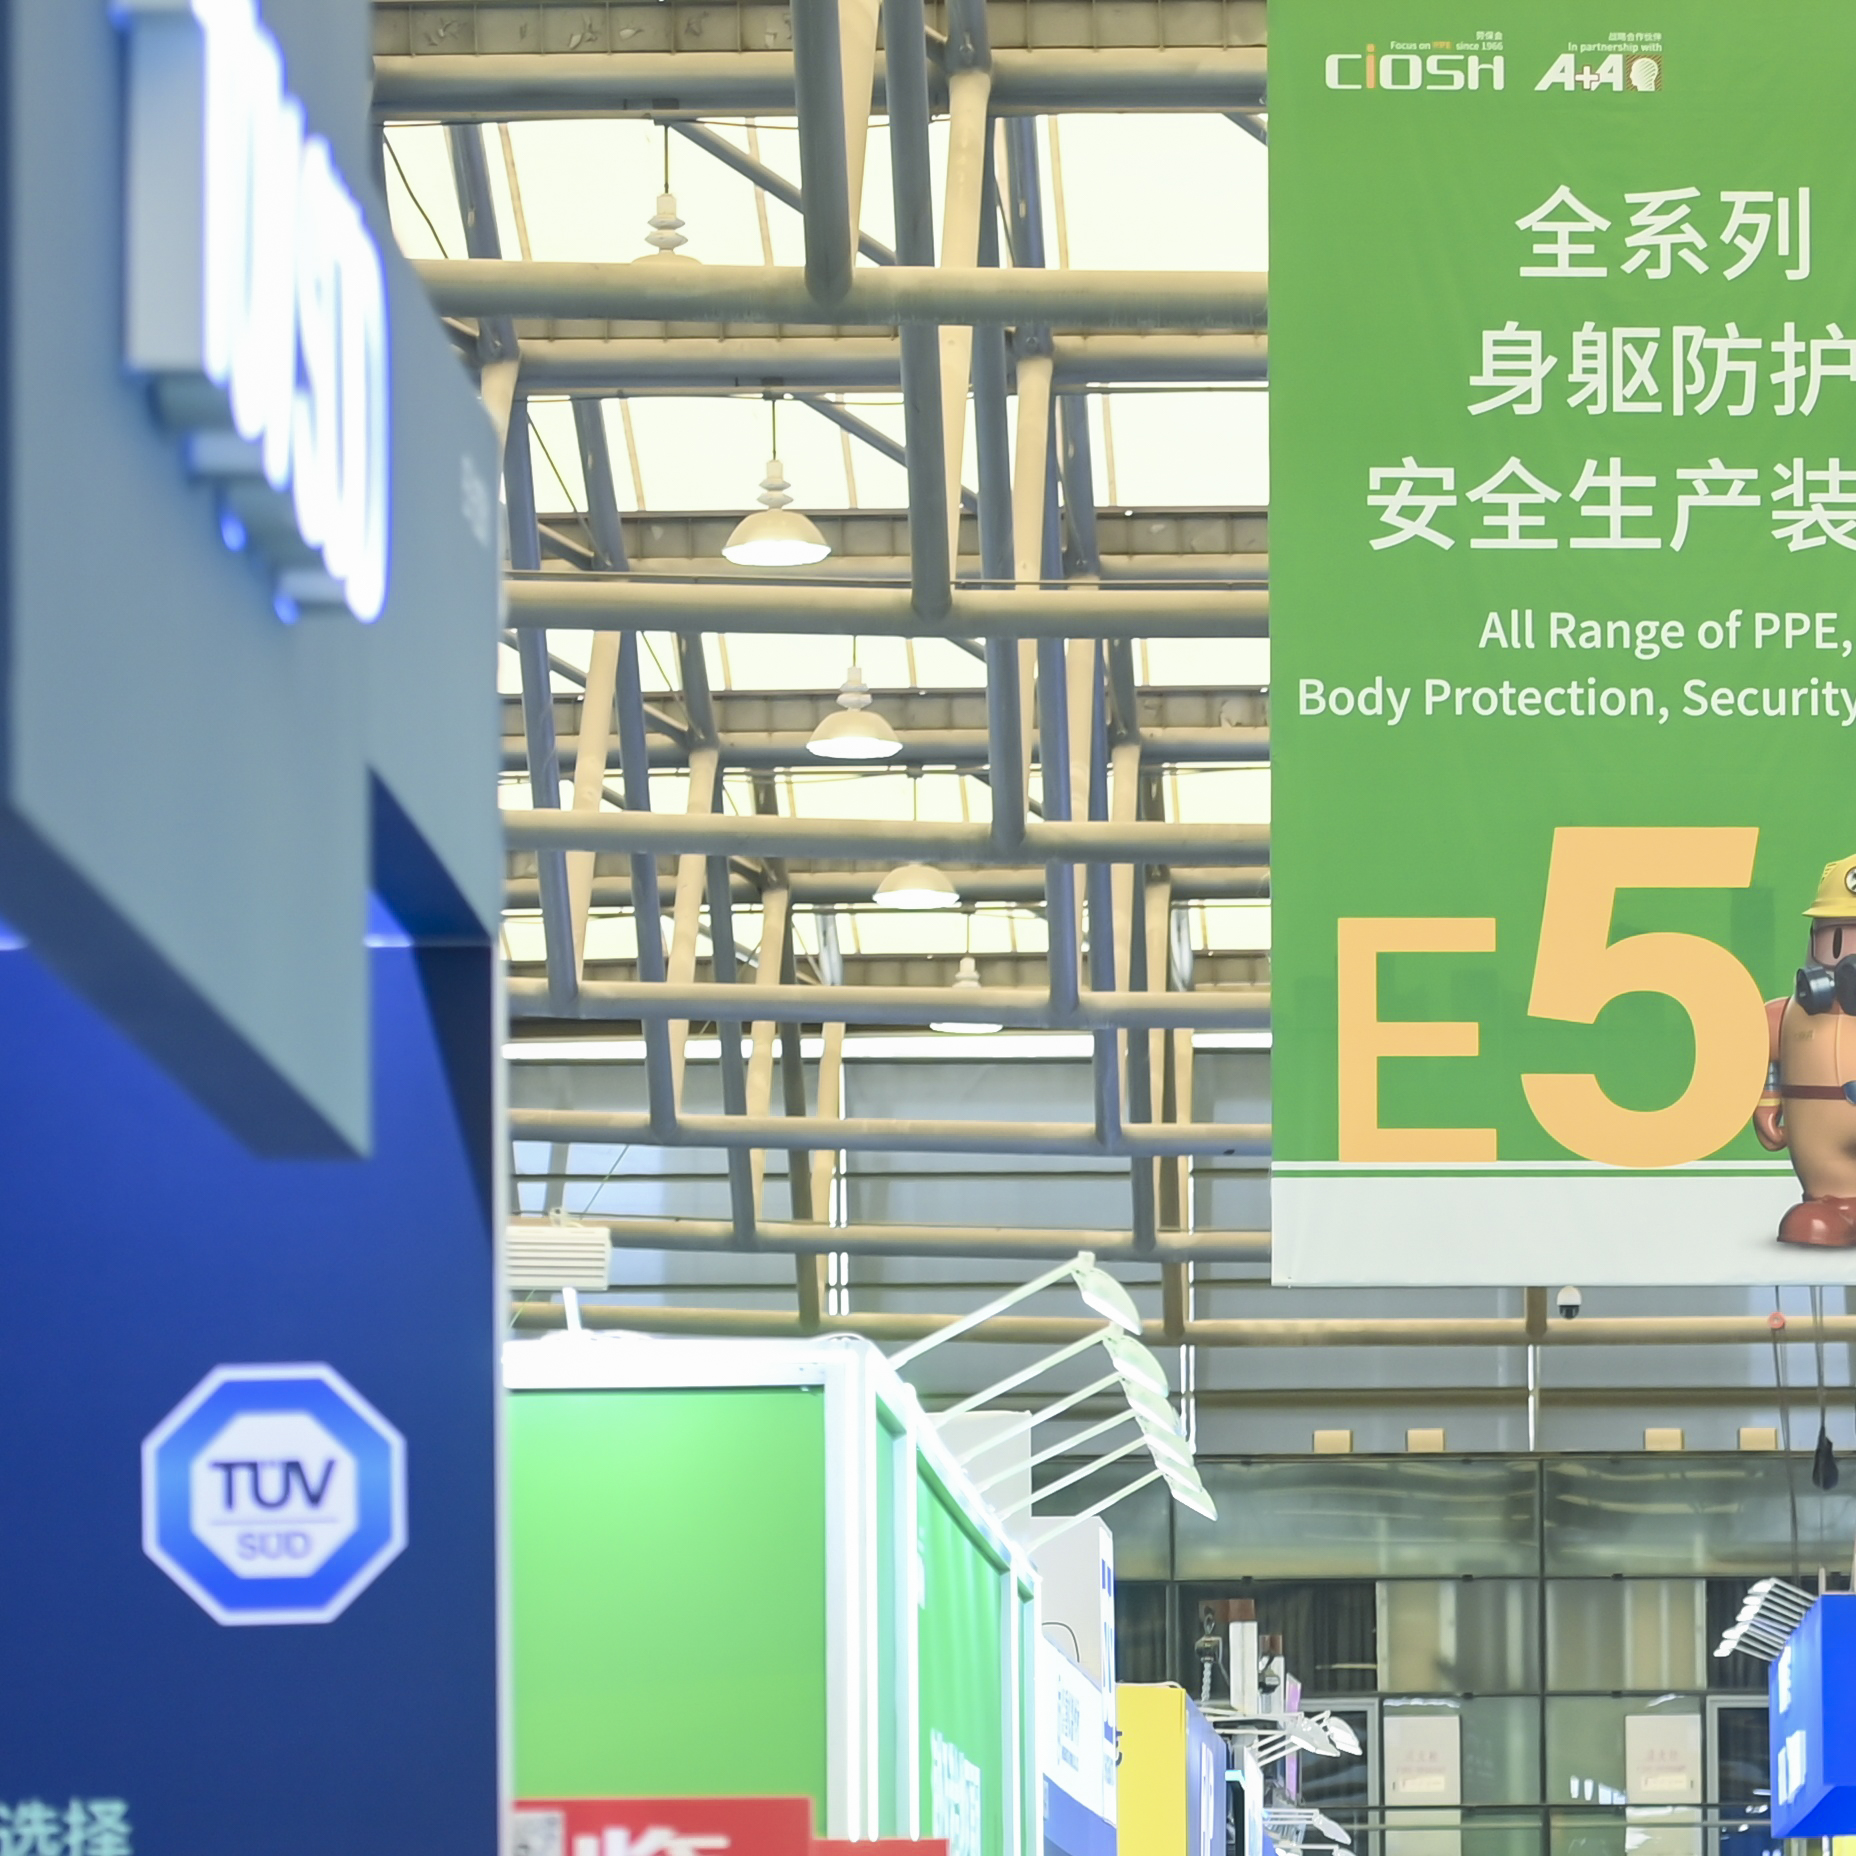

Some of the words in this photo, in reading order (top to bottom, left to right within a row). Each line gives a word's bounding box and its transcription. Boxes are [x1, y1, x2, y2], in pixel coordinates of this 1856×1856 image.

[1580, 42, 1639, 53] partnership
[1641, 42, 1662, 51] with
[1515, 185, 1811, 281] 全系列
[1478, 609, 1535, 650] All
[1549, 609, 1686, 660] Range
[1698, 609, 1742, 650] of
[1755, 611, 1854, 658] PPE,
[1299, 676, 1411, 726] Body
[1424, 676, 1669, 726] Protection,
[1337, 826, 1771, 1169] E5
